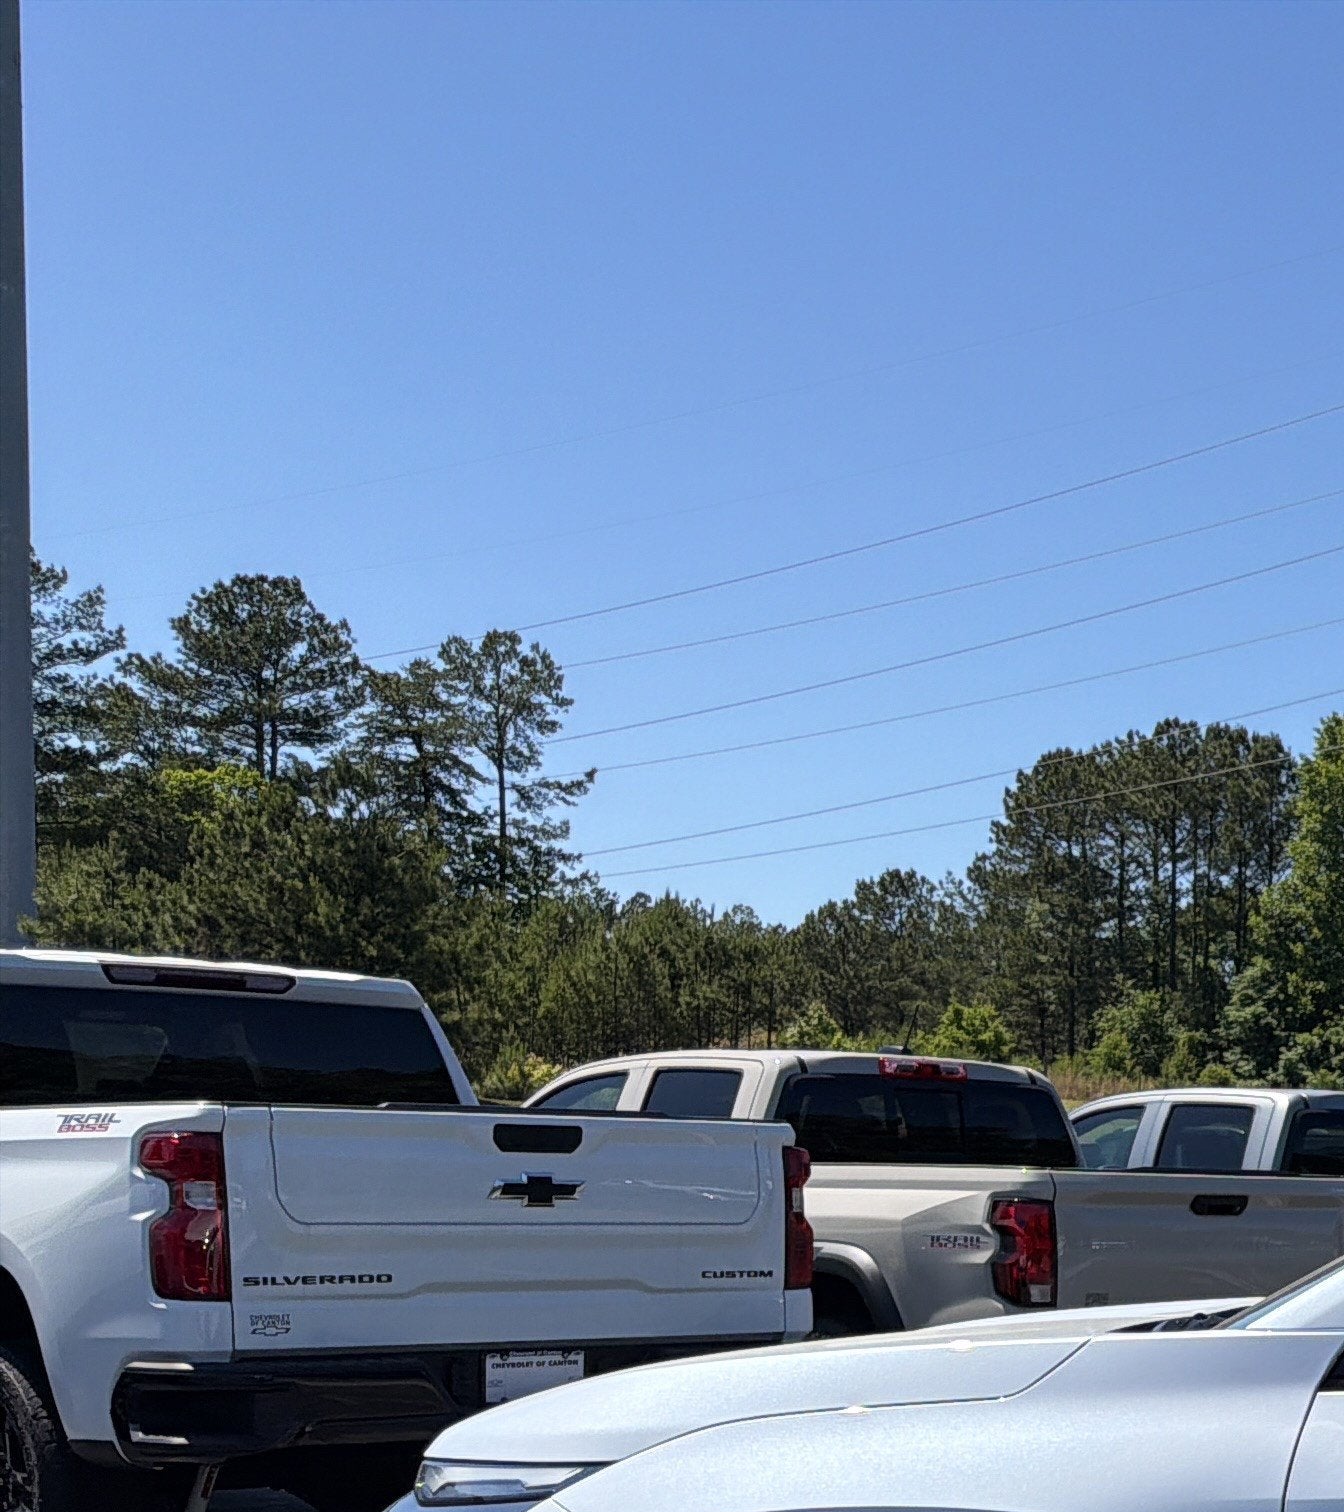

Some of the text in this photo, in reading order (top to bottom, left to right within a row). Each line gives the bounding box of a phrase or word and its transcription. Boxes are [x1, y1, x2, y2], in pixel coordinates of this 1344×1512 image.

[57, 1112, 121, 1124] TRAIL
[57, 1123, 110, 1133] BOSS
[701, 1269, 773, 1279] CUSTOM
[242, 1273, 393, 1287] SILVERADO
[491, 1361, 533, 1369] CHEVROLET
[548, 1359, 579, 1367] CANTON
